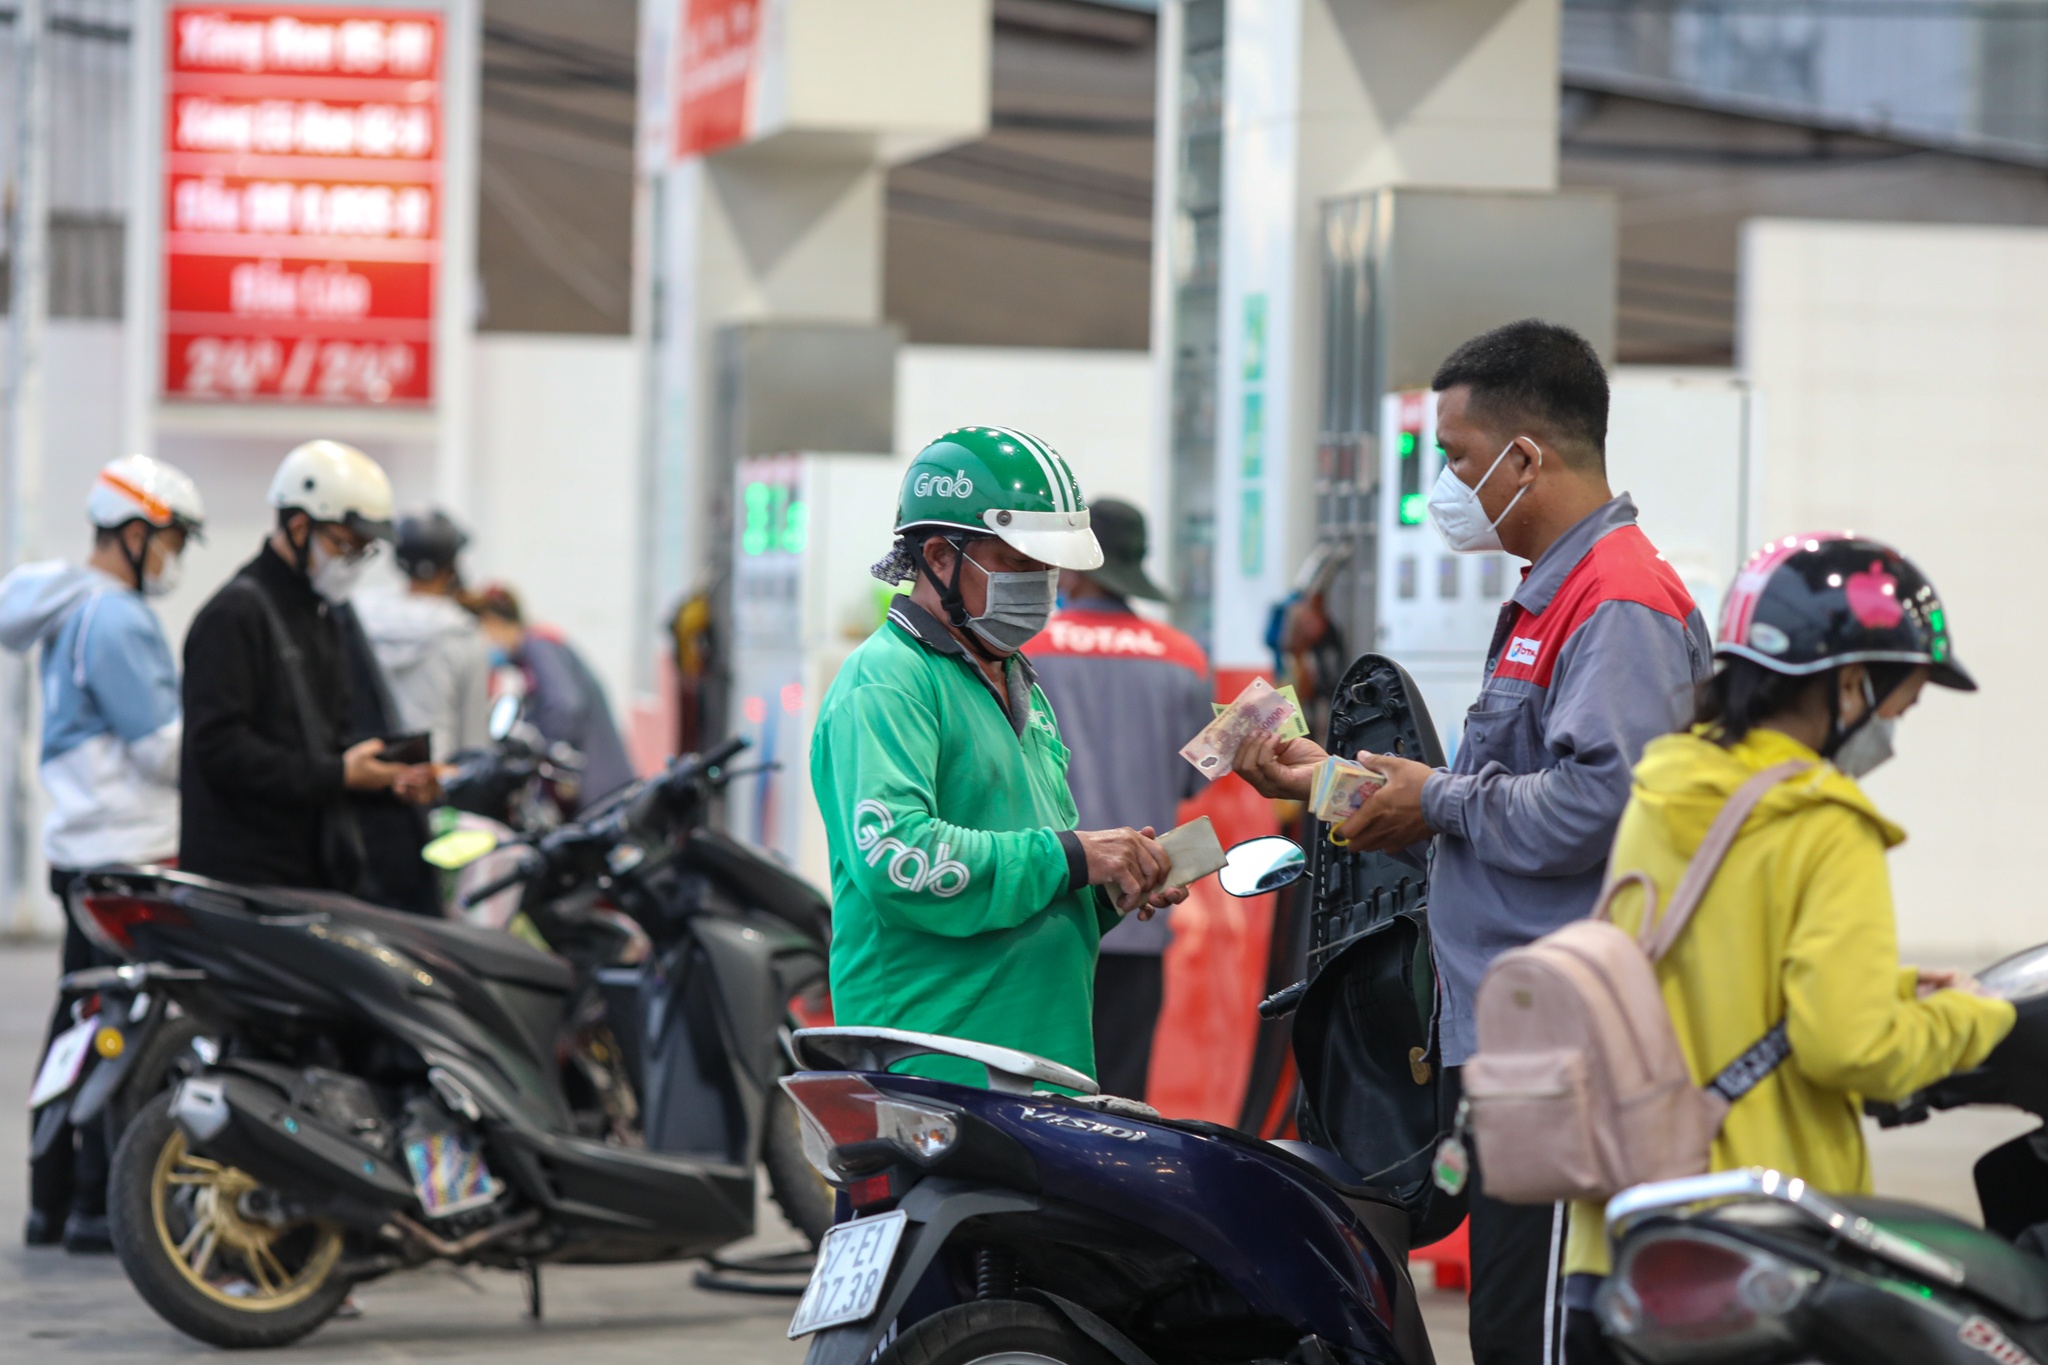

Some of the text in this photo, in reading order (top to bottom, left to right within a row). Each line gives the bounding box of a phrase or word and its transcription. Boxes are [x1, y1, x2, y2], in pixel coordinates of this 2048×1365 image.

[913, 469, 974, 499] Grab
[1048, 619, 1167, 656] TOTAL
[853, 798, 971, 898] Grab
